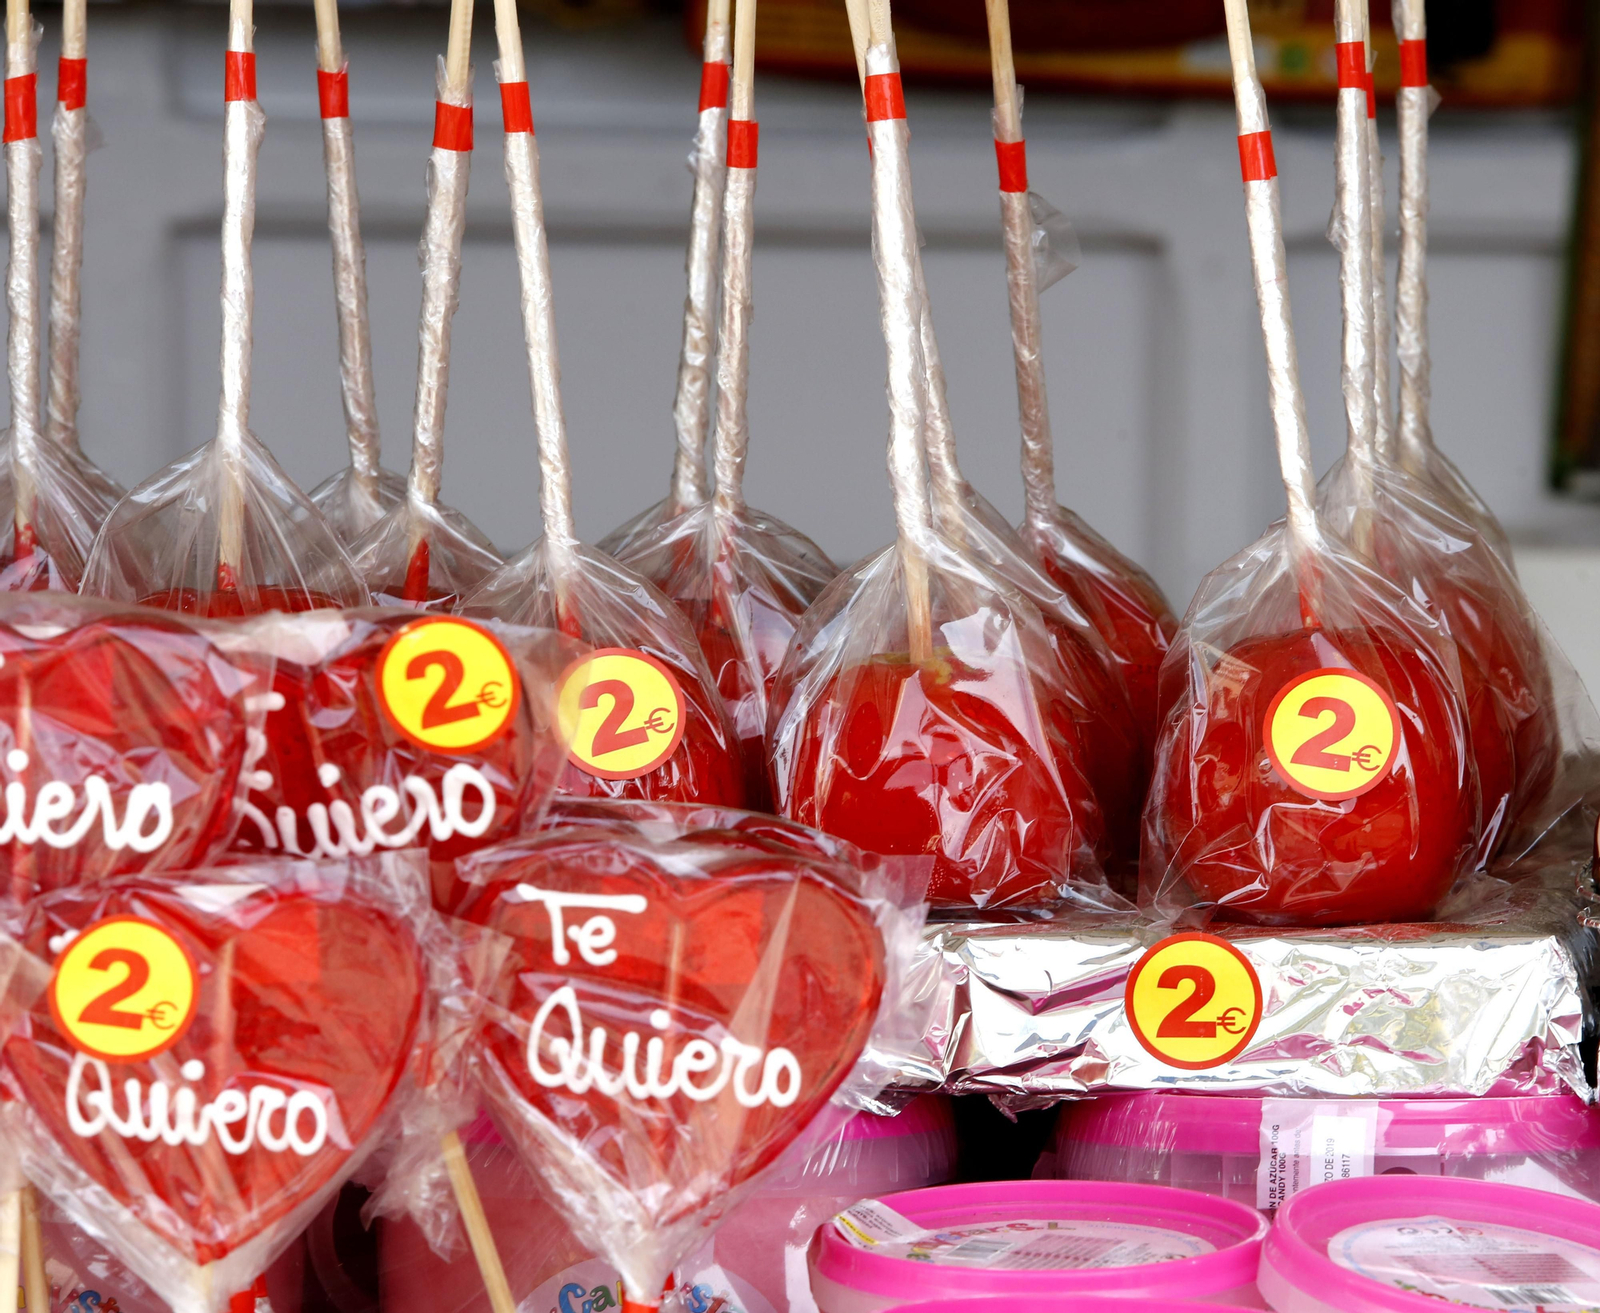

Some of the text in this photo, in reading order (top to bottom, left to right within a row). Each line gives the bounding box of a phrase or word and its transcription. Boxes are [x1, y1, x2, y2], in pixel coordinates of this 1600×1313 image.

[406, 650, 508, 731] 2€
[578, 679, 675, 757] 2€
[1290, 696, 1382, 772] 2€
[0, 749, 173, 853] iero
[516, 884, 648, 966] Te
[77, 947, 178, 1031] 2€
[1156, 965, 1247, 1038] 2€
[527, 986, 802, 1108] Quiero
[66, 1050, 327, 1155] Quiero
[1271, 1124, 1280, 1144] 100G
[1268, 1147, 1278, 1185] AZÚCAR
[1324, 1158, 1334, 1170] DE
[1325, 1138, 1335, 1157] 2019
[1341, 1153, 1350, 1178] 86117
[1269, 1186, 1277, 1199] DE
